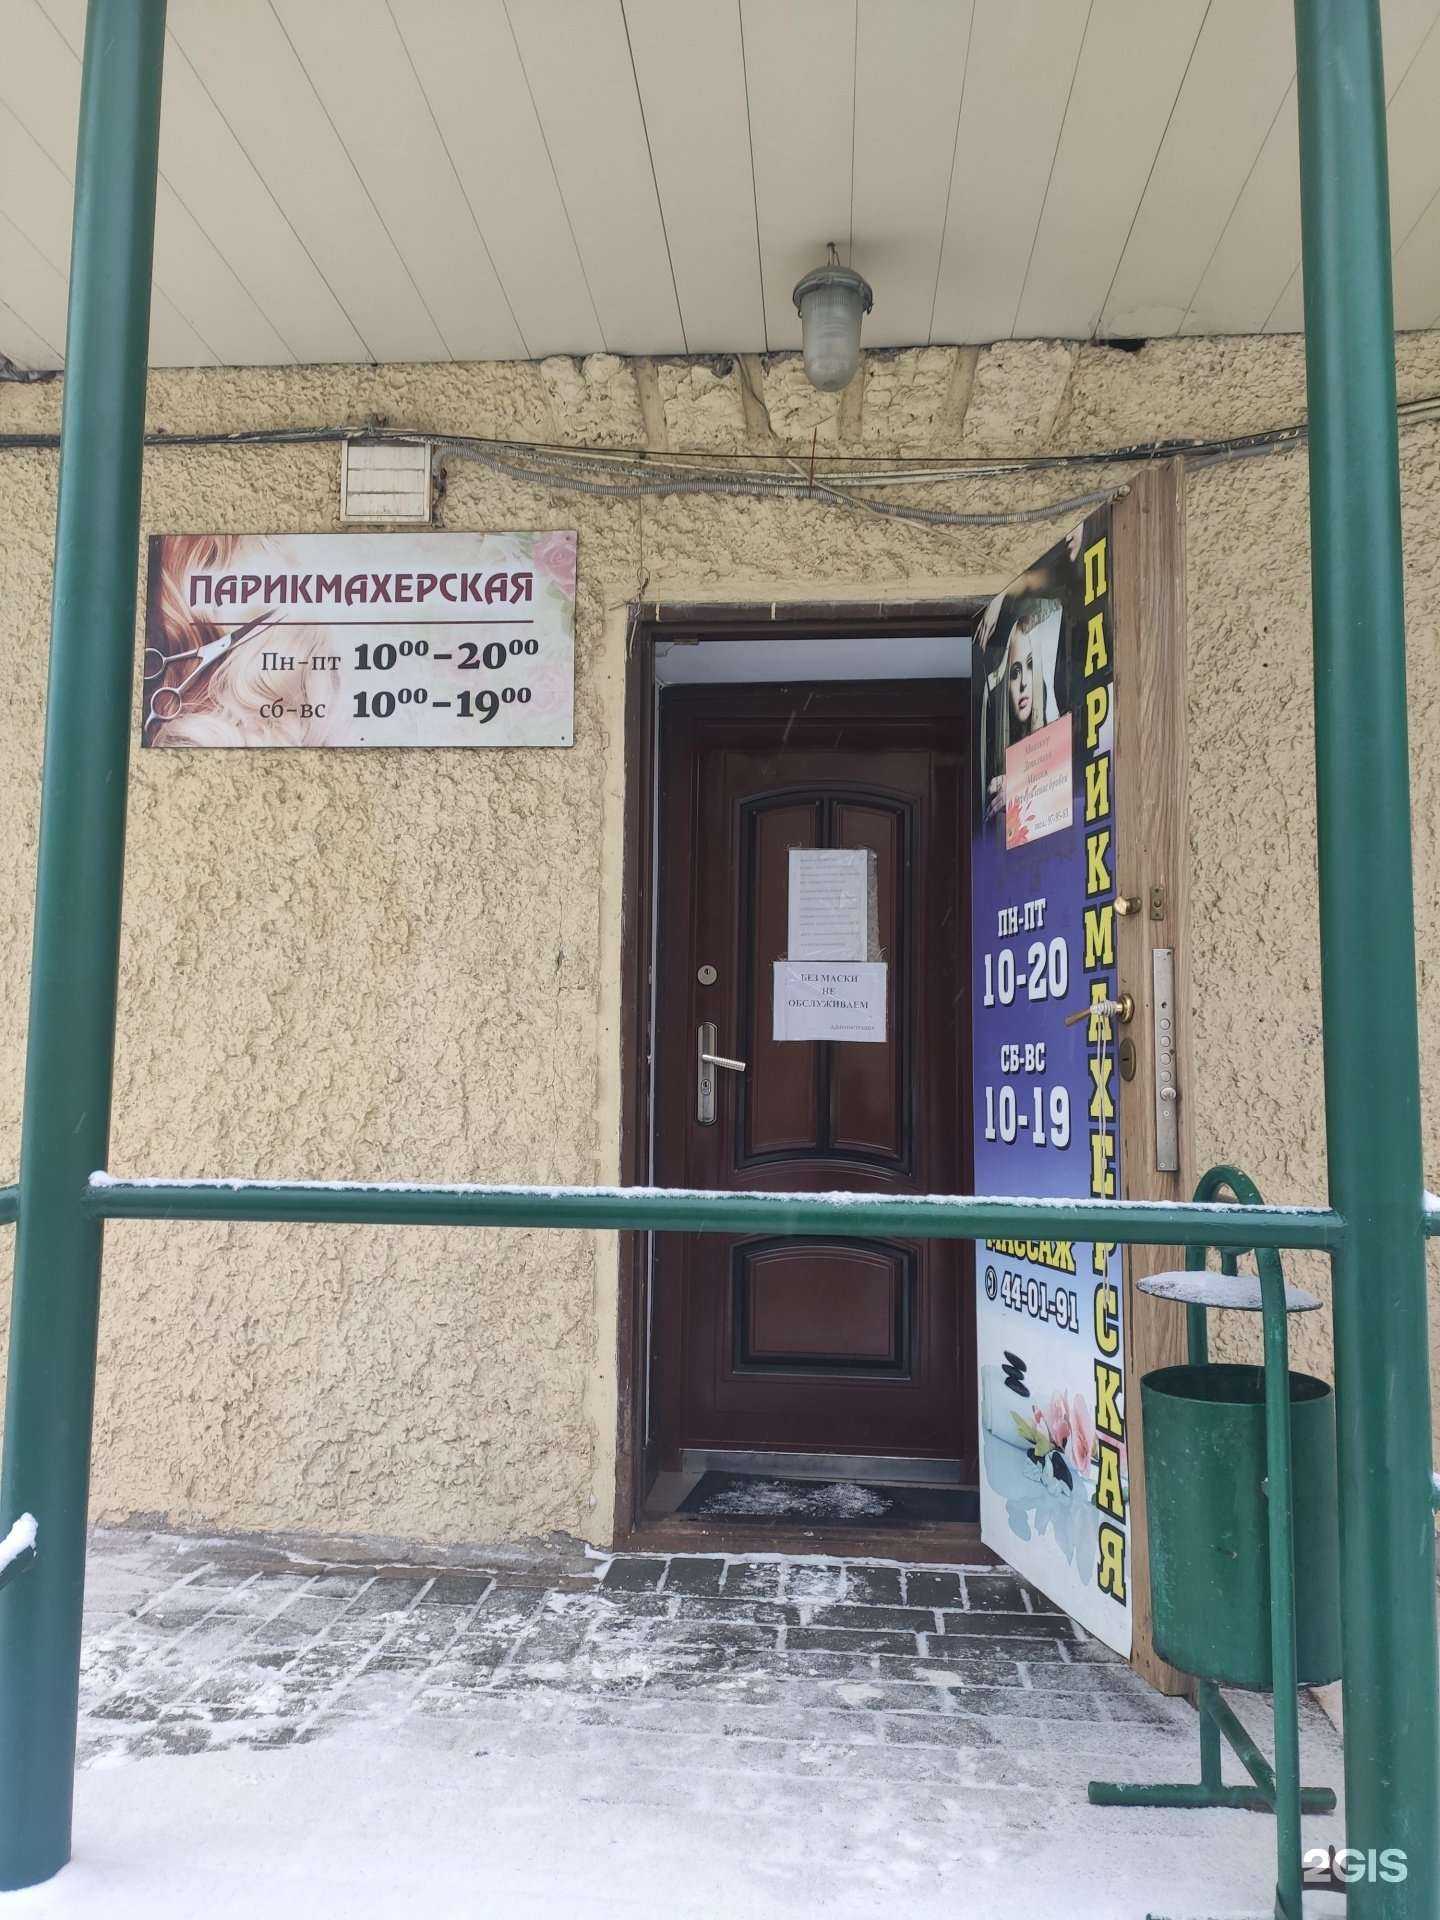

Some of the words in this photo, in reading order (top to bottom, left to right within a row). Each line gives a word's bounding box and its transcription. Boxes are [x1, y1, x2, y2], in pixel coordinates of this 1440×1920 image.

[188, 571, 534, 608] ПАРИКМАХЕРСКАЯ
[261, 652, 341, 672] Пн-пт
[259, 698, 326, 719] сб-вс
[998, 898, 1046, 939] ПН-ПТ
[801, 973, 818, 982] БЕЗ
[821, 974, 858, 983] МАСКИ
[983, 937, 1069, 1009] 10-20
[788, 999, 869, 1009] ОБСЛУЖИВАЕМ
[821, 987, 836, 995] НЕ
[1000, 1041, 1047, 1074] СБ-ВС
[985, 1085, 1072, 1150] 10-19
[1001, 1270, 1079, 1334] 44-01-91
